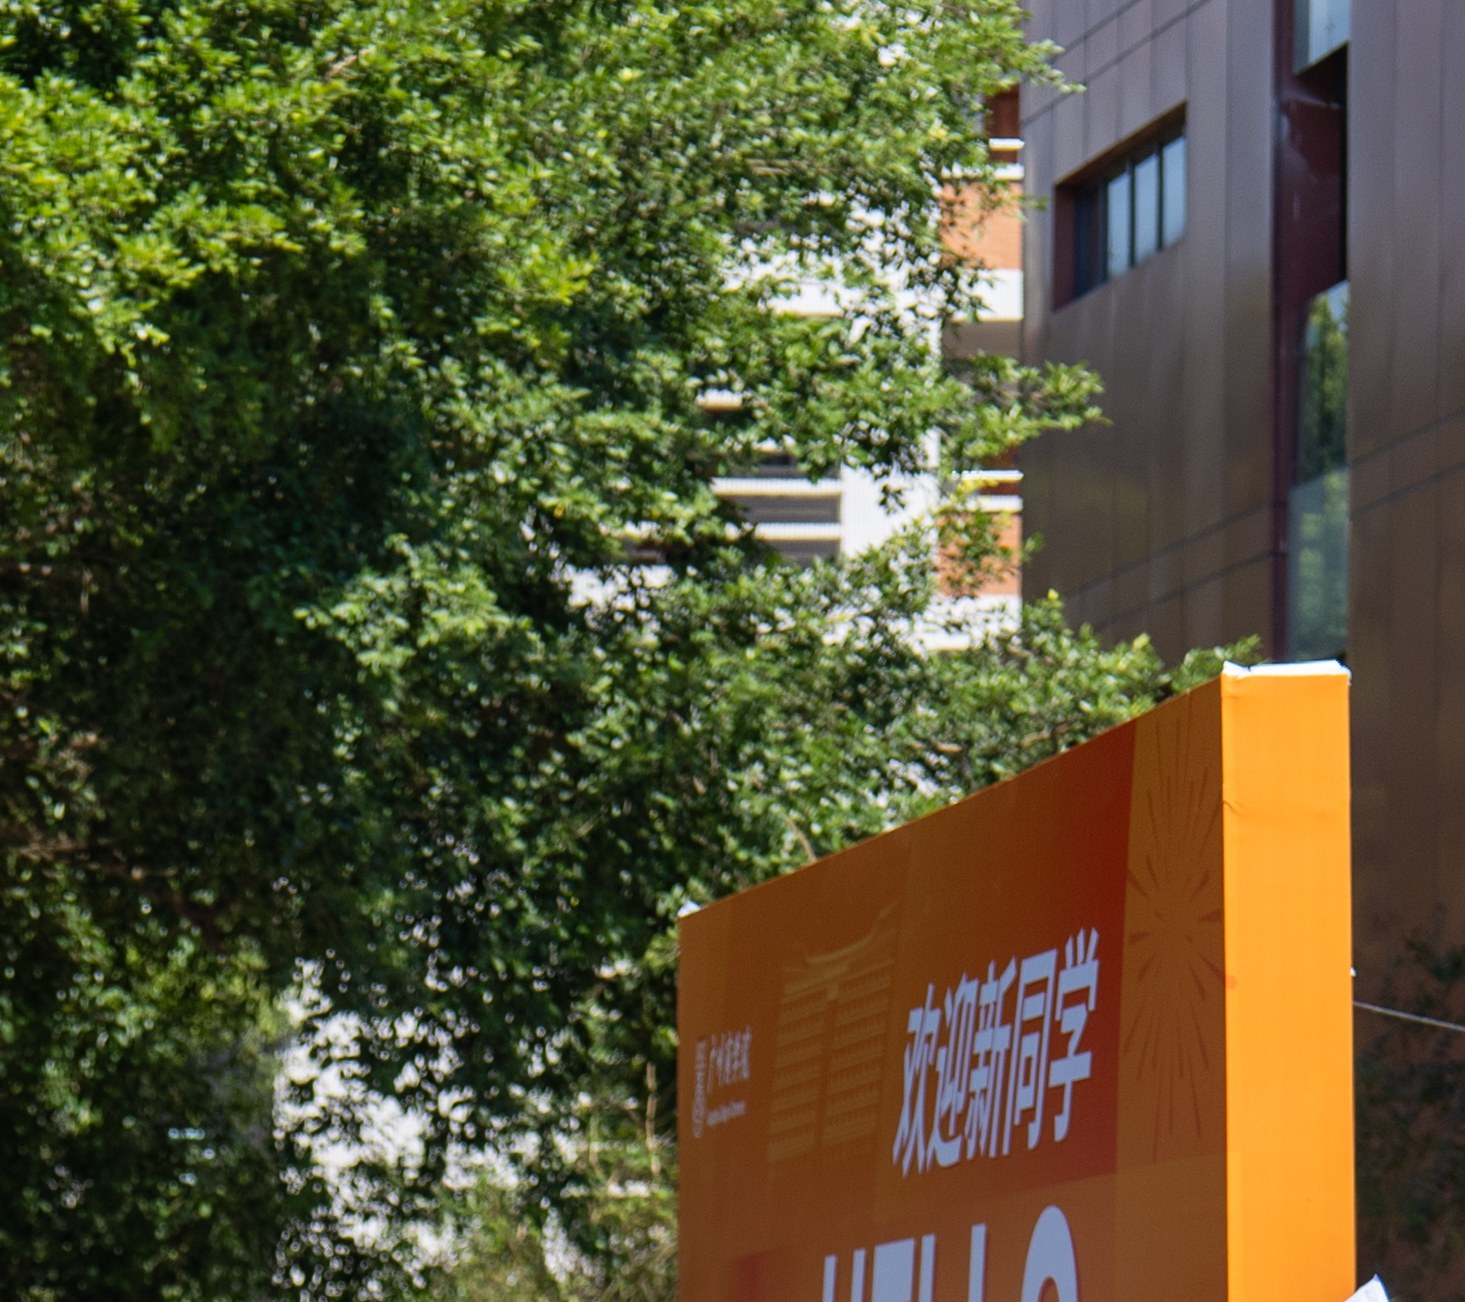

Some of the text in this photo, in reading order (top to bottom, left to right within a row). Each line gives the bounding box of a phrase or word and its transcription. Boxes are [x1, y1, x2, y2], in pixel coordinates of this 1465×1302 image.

[892, 927, 1100, 1178] 欢迎新同学
